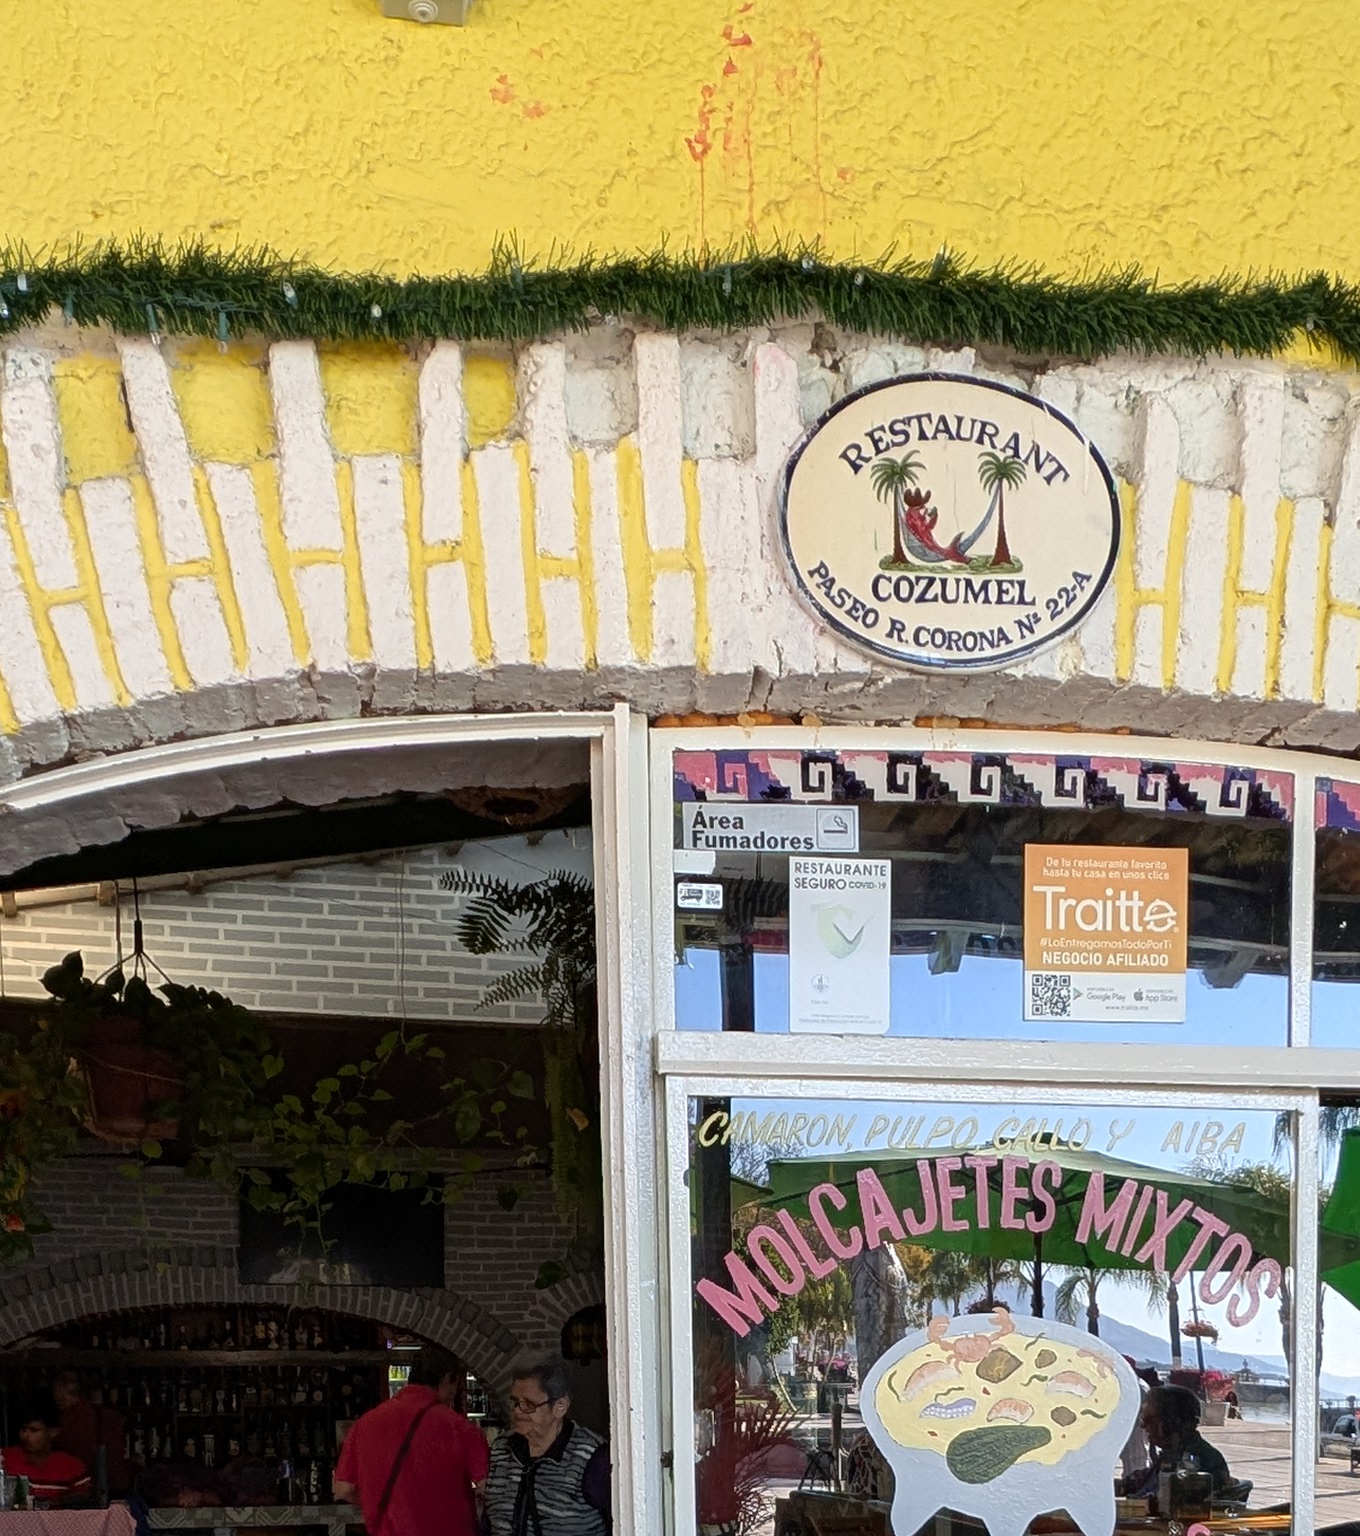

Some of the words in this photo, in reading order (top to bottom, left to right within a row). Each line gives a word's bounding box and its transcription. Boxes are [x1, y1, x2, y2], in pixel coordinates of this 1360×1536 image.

[838, 412, 1070, 487] RESTAURANT
[807, 560, 880, 630] PASEO
[1045, 569, 1093, 622] 22-A
[871, 573, 1036, 607] COZUMEL
[691, 804, 745, 830] Área
[691, 830, 815, 850] Fumadores
[793, 861, 887, 877] RESTAURANTE
[1043, 868, 1070, 878] hasta
[1071, 869, 1082, 879] tu
[1083, 870, 1106, 879] casa
[1108, 871, 1120, 879] en
[1122, 871, 1146, 880] unos
[1046, 857, 1058, 867] De
[1073, 858, 1129, 870] restaurante
[1130, 859, 1167, 870] favorito
[793, 876, 846, 891] SEGURO
[848, 880, 887, 890] COVID-19
[1042, 951, 1103, 966] NEGOCIO
[1106, 953, 1169, 967] AFILIADO
[697, 1110, 857, 1154] CAMARON,
[863, 1115, 983, 1154] PULPO,
[992, 1116, 1092, 1154] CALLO
[1105, 1118, 1136, 1153] Y
[695, 1155, 1063, 1338] MOLCAJETES
[1074, 1168, 1282, 1329] MIXTOS
